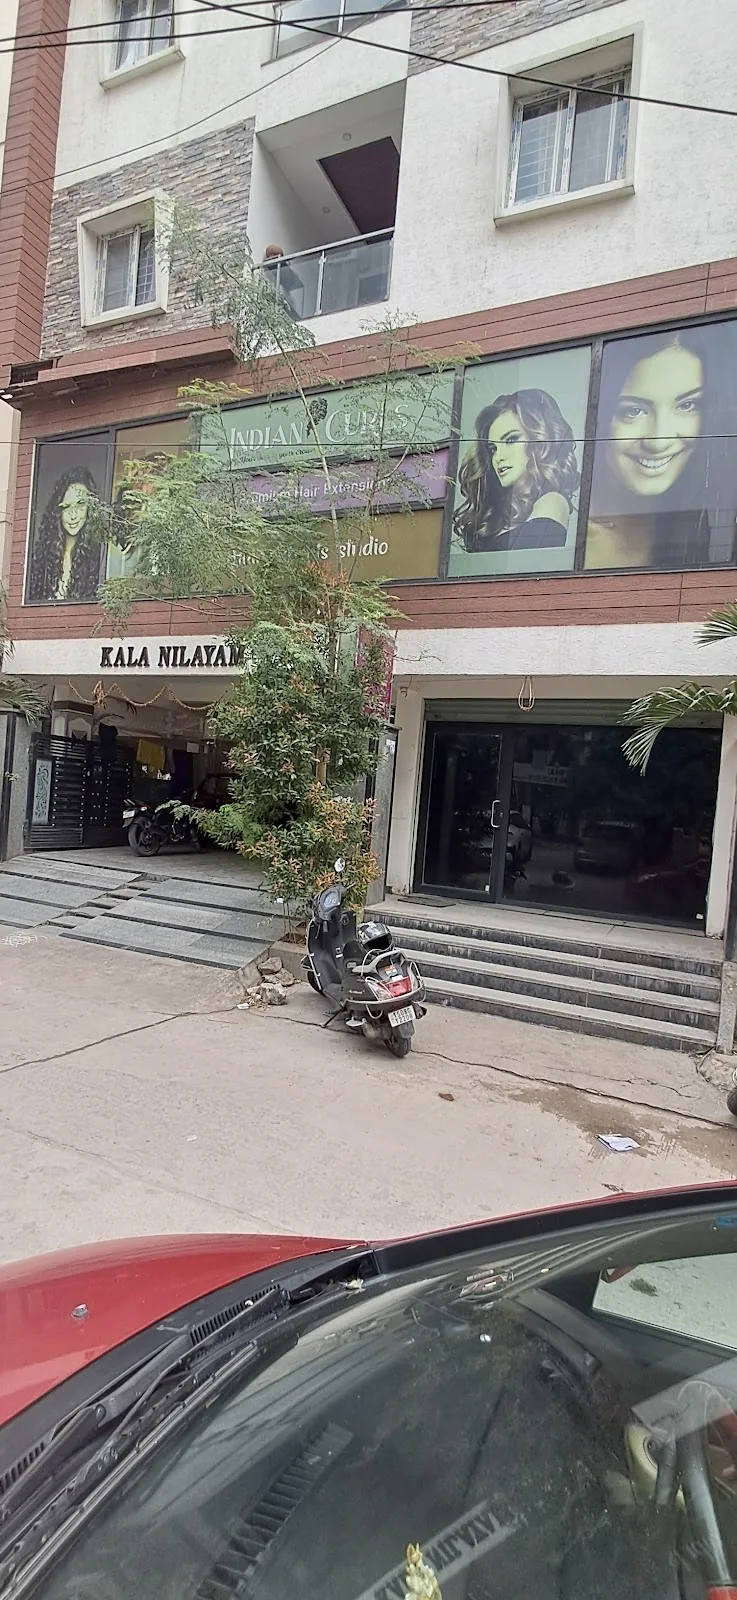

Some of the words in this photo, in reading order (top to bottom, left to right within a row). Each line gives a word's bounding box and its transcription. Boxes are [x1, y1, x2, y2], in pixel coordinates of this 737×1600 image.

[229, 421, 303, 459] INDIAN
[294, 484, 319, 498] Hair
[100, 646, 150, 668] KALA
